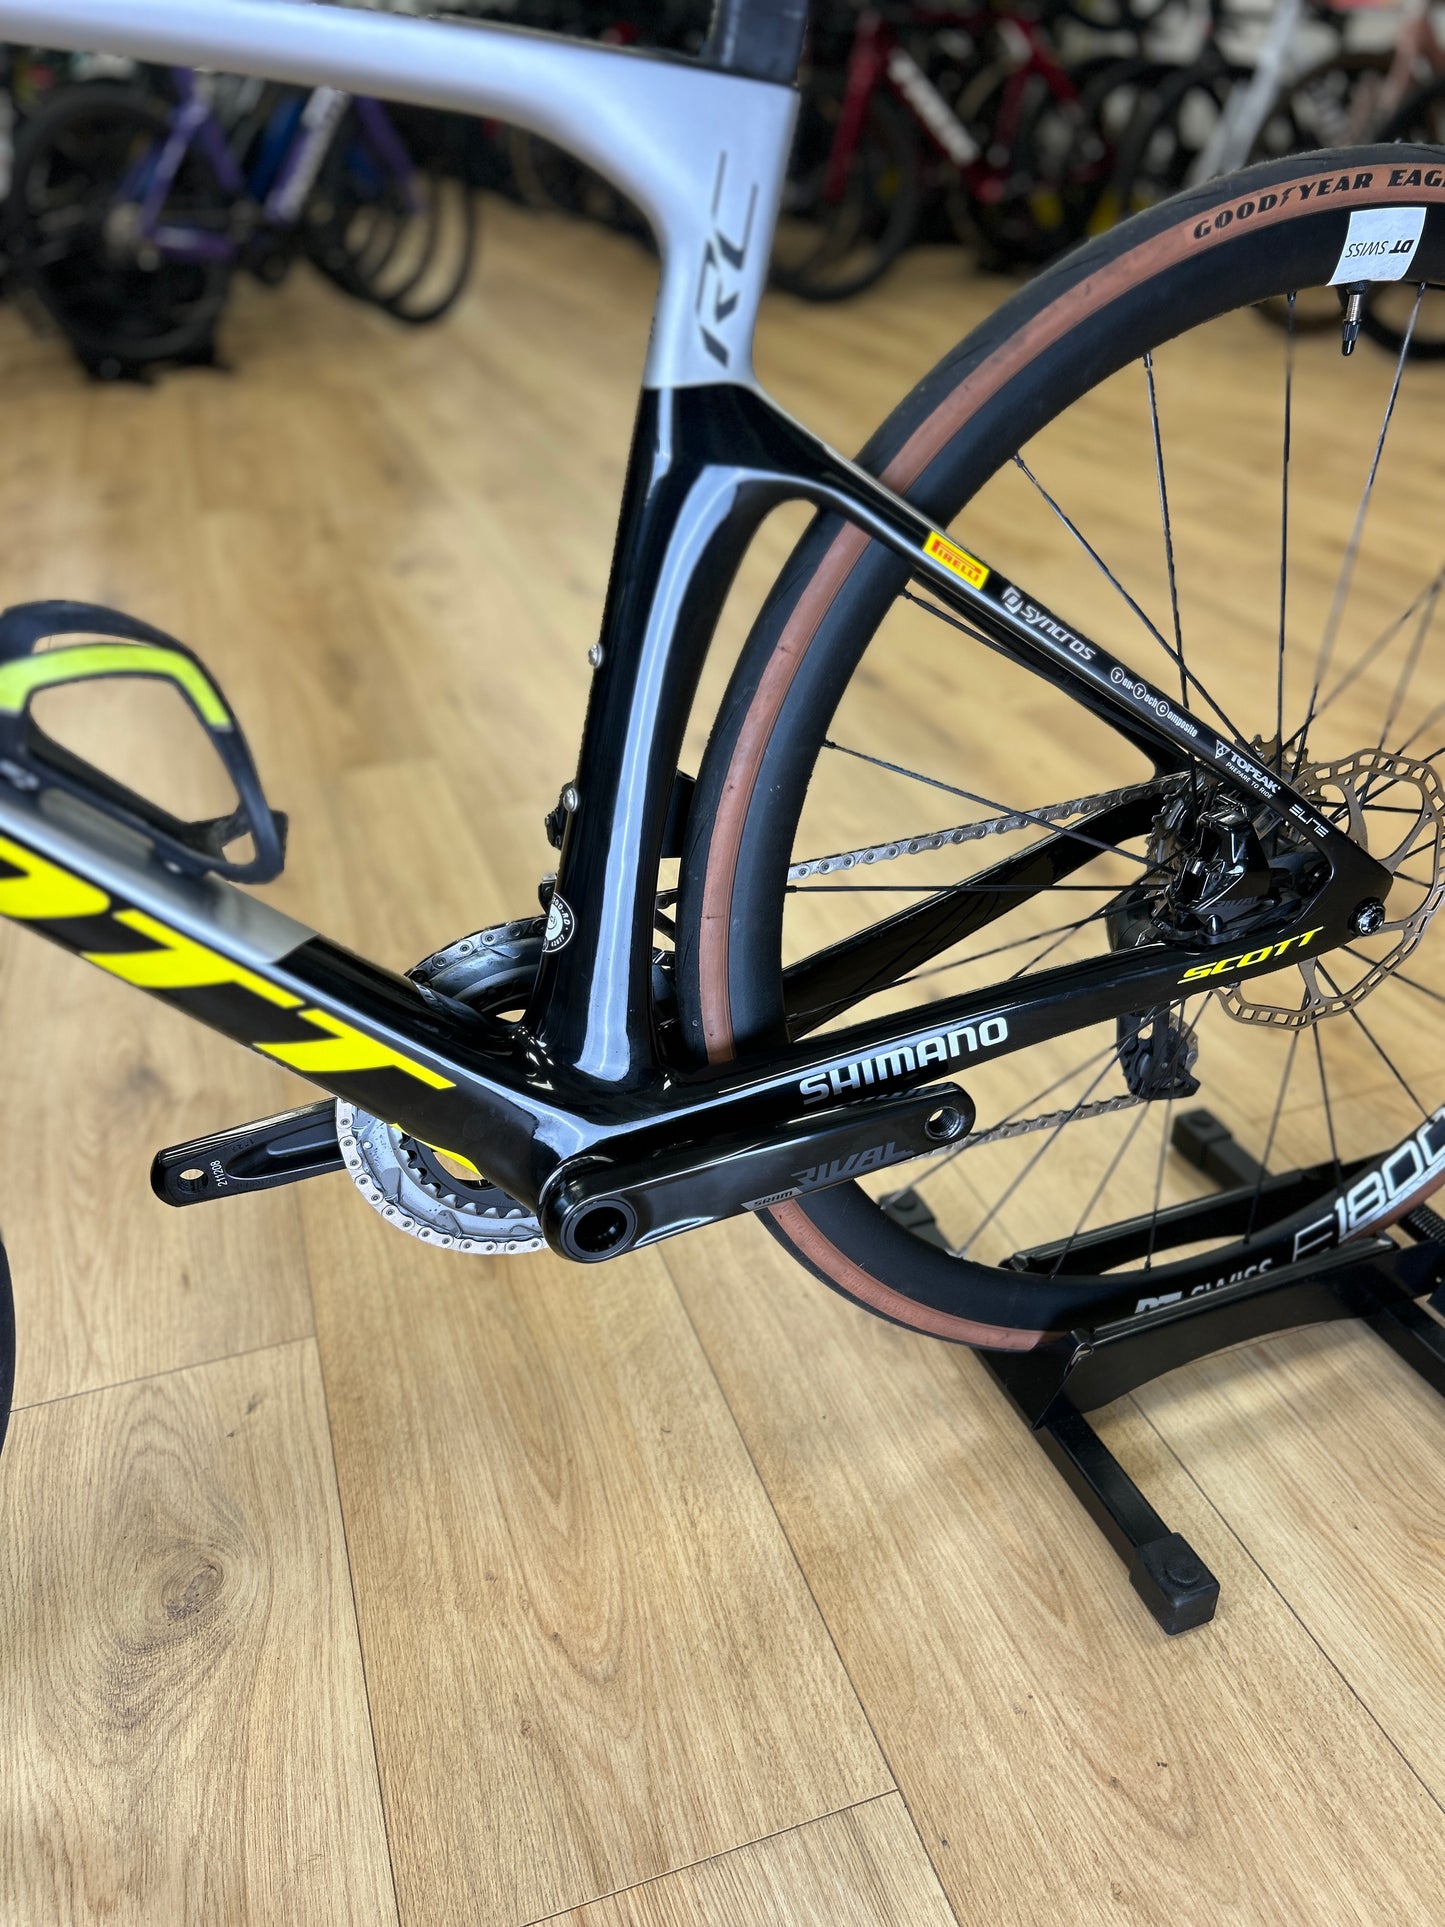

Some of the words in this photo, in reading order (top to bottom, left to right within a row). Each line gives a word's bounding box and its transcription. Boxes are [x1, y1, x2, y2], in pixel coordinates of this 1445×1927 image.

[1193, 172, 1374, 240] GOODYEAR
[1387, 168, 1445, 188] EAG
[1345, 239, 1389, 259] SWISS
[1388, 239, 1415, 254] DT
[931, 538, 983, 582] PIRELLI
[1225, 761, 1251, 783] PREPARE
[1250, 780, 1259, 790] TO
[1230, 750, 1278, 794] TOPEAK
[1288, 803, 1330, 838] ELITE
[1176, 925, 1325, 985] SCOTT
[799, 1016, 1009, 1105] SHIMANO
[210, 1159, 228, 1187] 211208
[790, 1141, 916, 1190] RIVAL
[753, 1189, 794, 1208] SRAM
